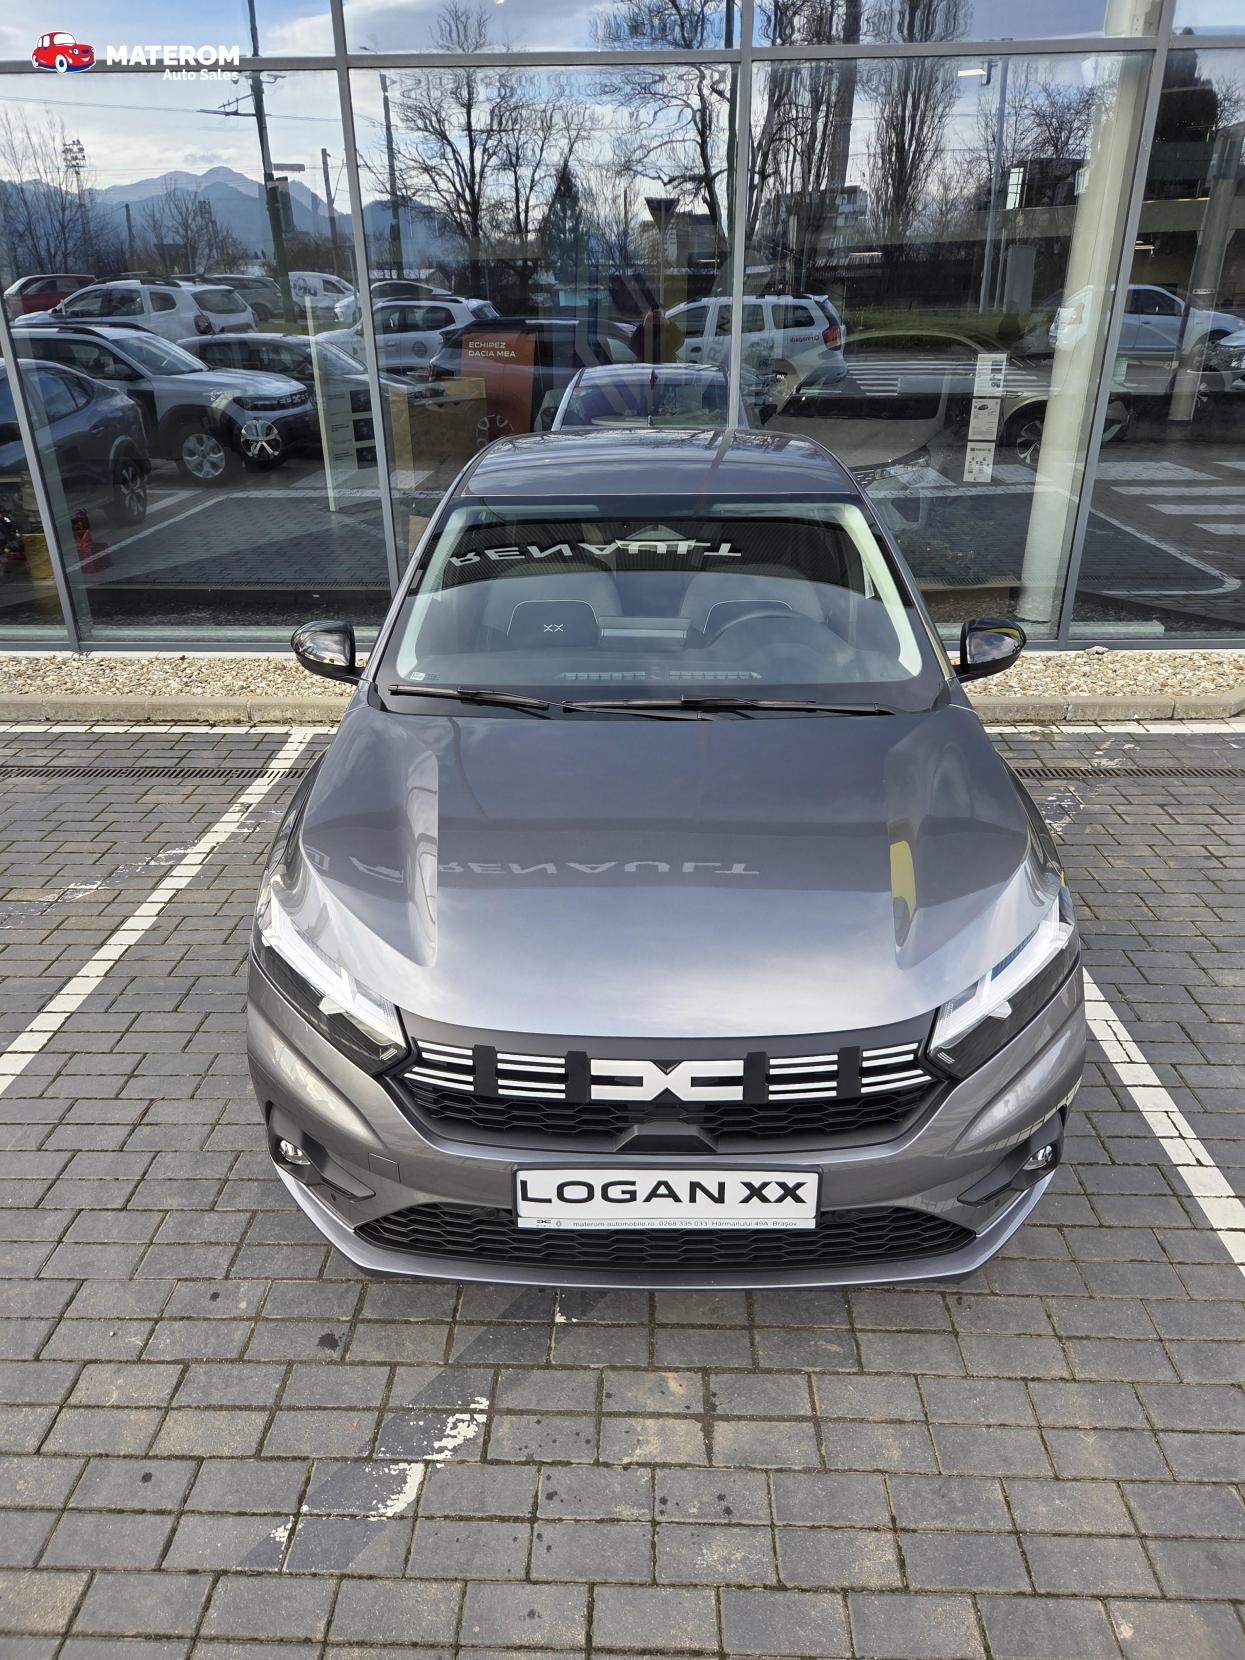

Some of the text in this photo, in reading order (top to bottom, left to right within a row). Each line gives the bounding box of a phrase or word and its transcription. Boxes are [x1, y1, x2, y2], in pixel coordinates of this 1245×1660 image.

[468, 341, 506, 349] ECHIPEZ
[519, 1179, 809, 1205] LOGAN XX
